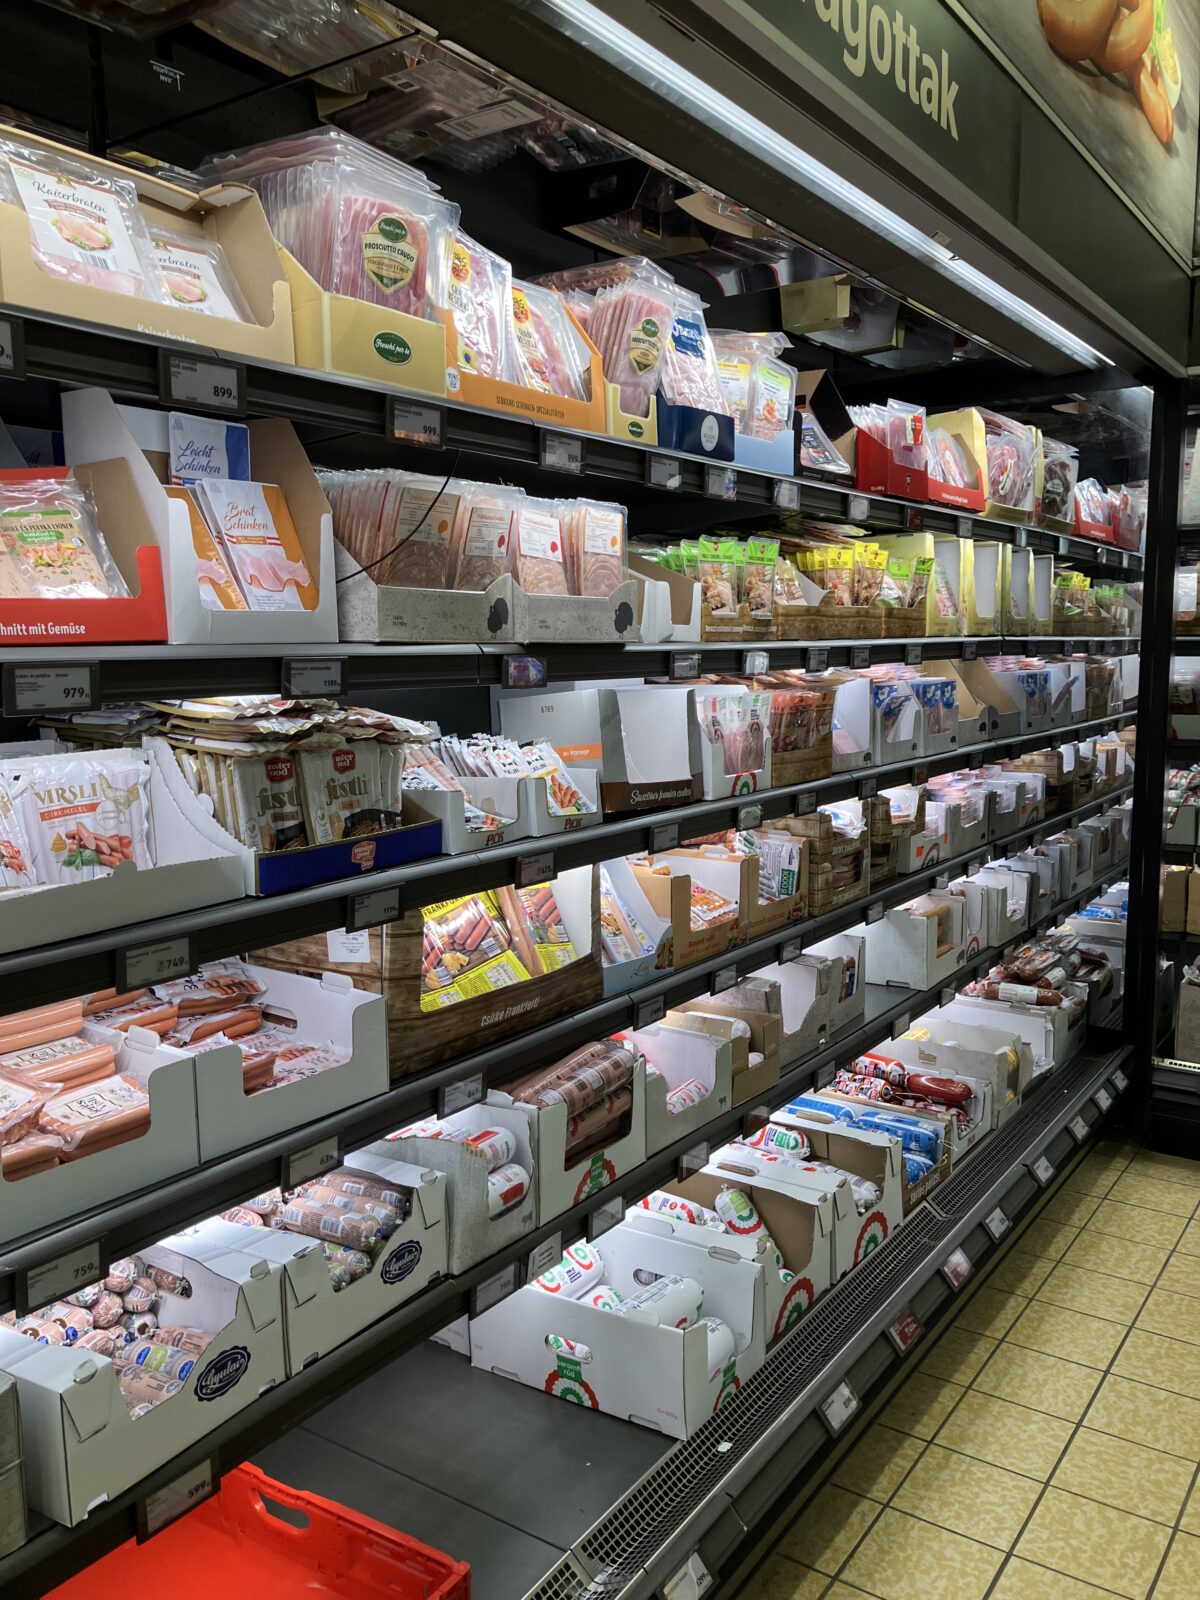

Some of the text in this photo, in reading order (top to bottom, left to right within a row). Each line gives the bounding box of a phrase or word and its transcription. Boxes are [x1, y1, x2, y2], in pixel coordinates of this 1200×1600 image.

[212, 385, 232, 400] 899
[423, 424, 438, 437] 999
[179, 440, 214, 459] Leicht
[175, 456, 222, 475] Schinken
[224, 513, 269, 532] Schinken
[29, 623, 46, 636] mit
[47, 622, 86, 636] Gemüse
[63, 687, 85, 699] 979
[33, 783, 98, 805] VIRSLI
[165, 957, 184, 974] 749
[73, 1262, 94, 1280] 759
